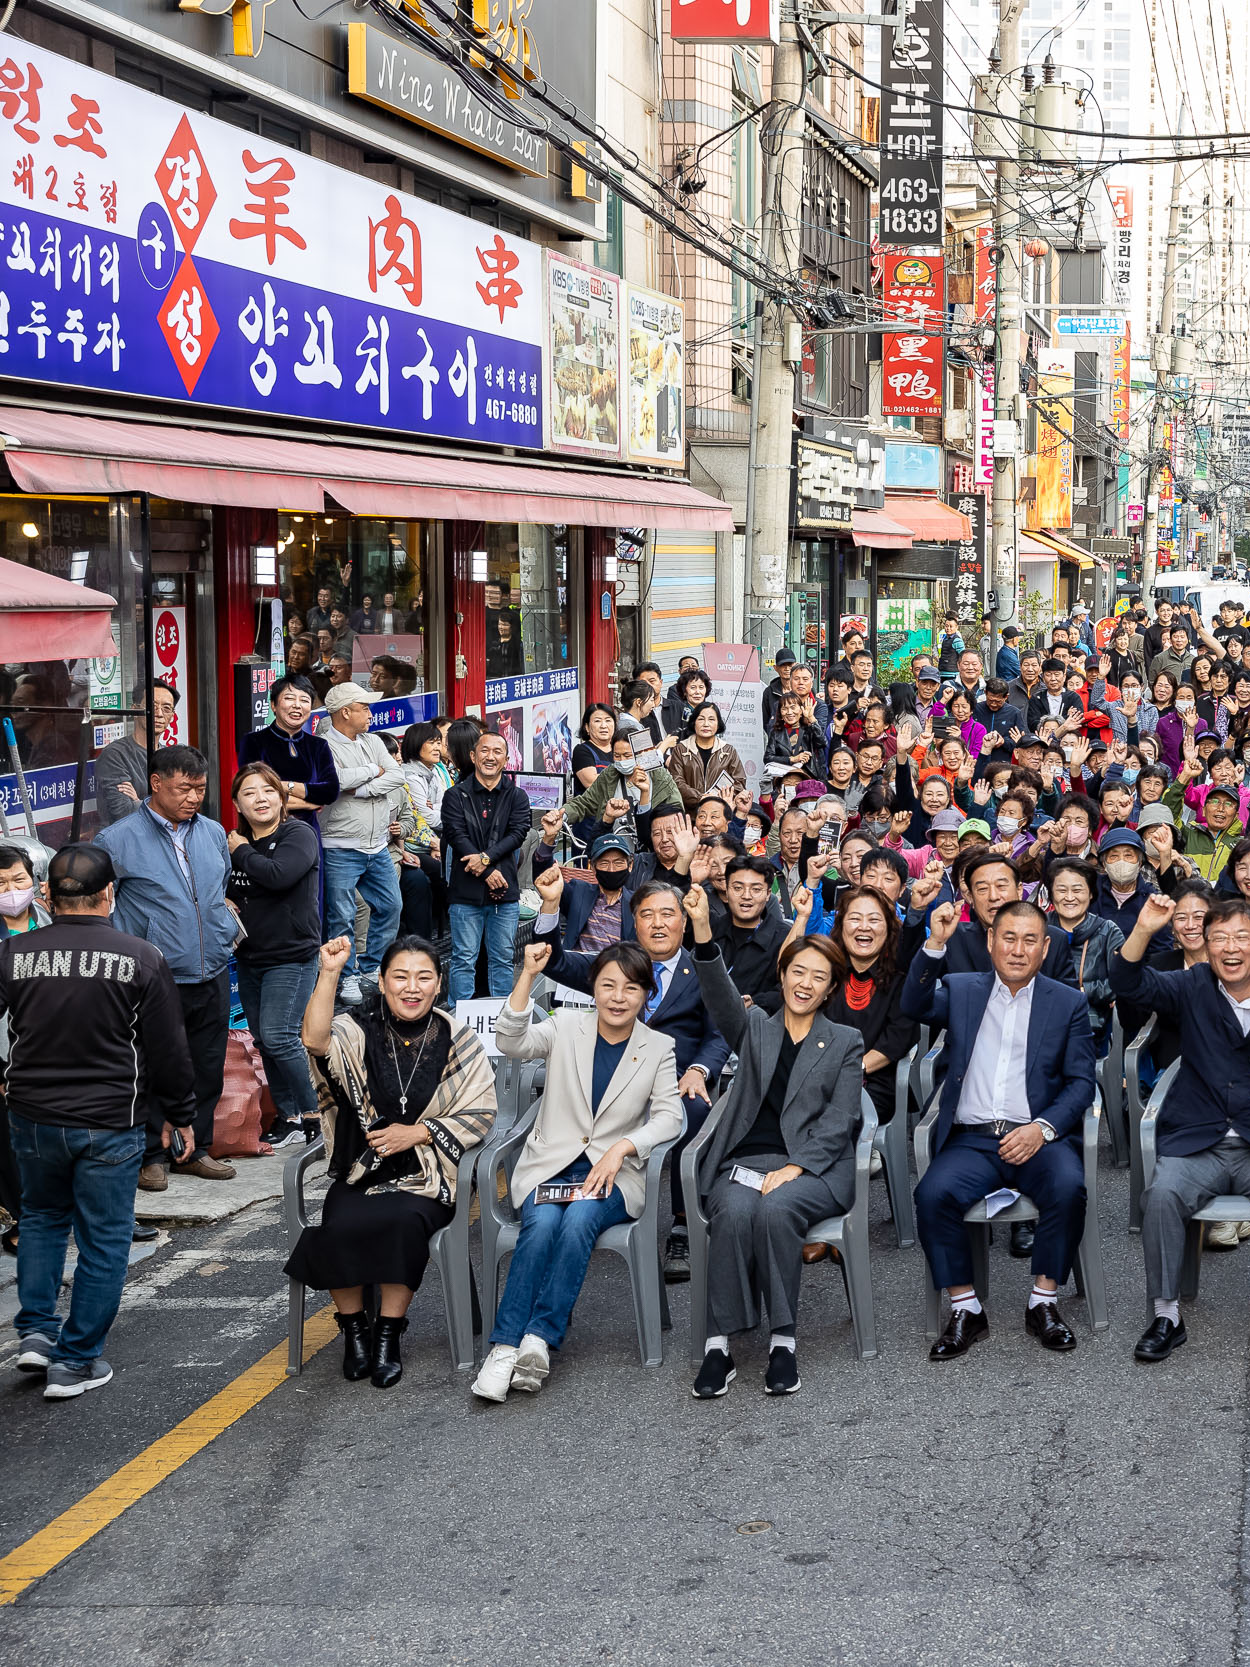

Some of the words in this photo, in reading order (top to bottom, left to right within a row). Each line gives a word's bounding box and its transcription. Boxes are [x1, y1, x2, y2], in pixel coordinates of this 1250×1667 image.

[0, 57, 108, 160] 원조
[378, 46, 436, 113] Nine
[512, 123, 543, 165] Bar
[887, 134, 936, 160] HOF
[229, 149, 524, 324] 羊肉串
[0, 221, 119, 304] 꼬치거리
[552, 268, 567, 289] KBS
[237, 281, 478, 426] 양꼬치구이
[486, 398, 538, 426] 467-6880
[157, 624, 178, 651] 원조
[254, 699, 270, 719] 오늘
[12, 950, 73, 981] MAN
[78, 951, 136, 983] UTD
